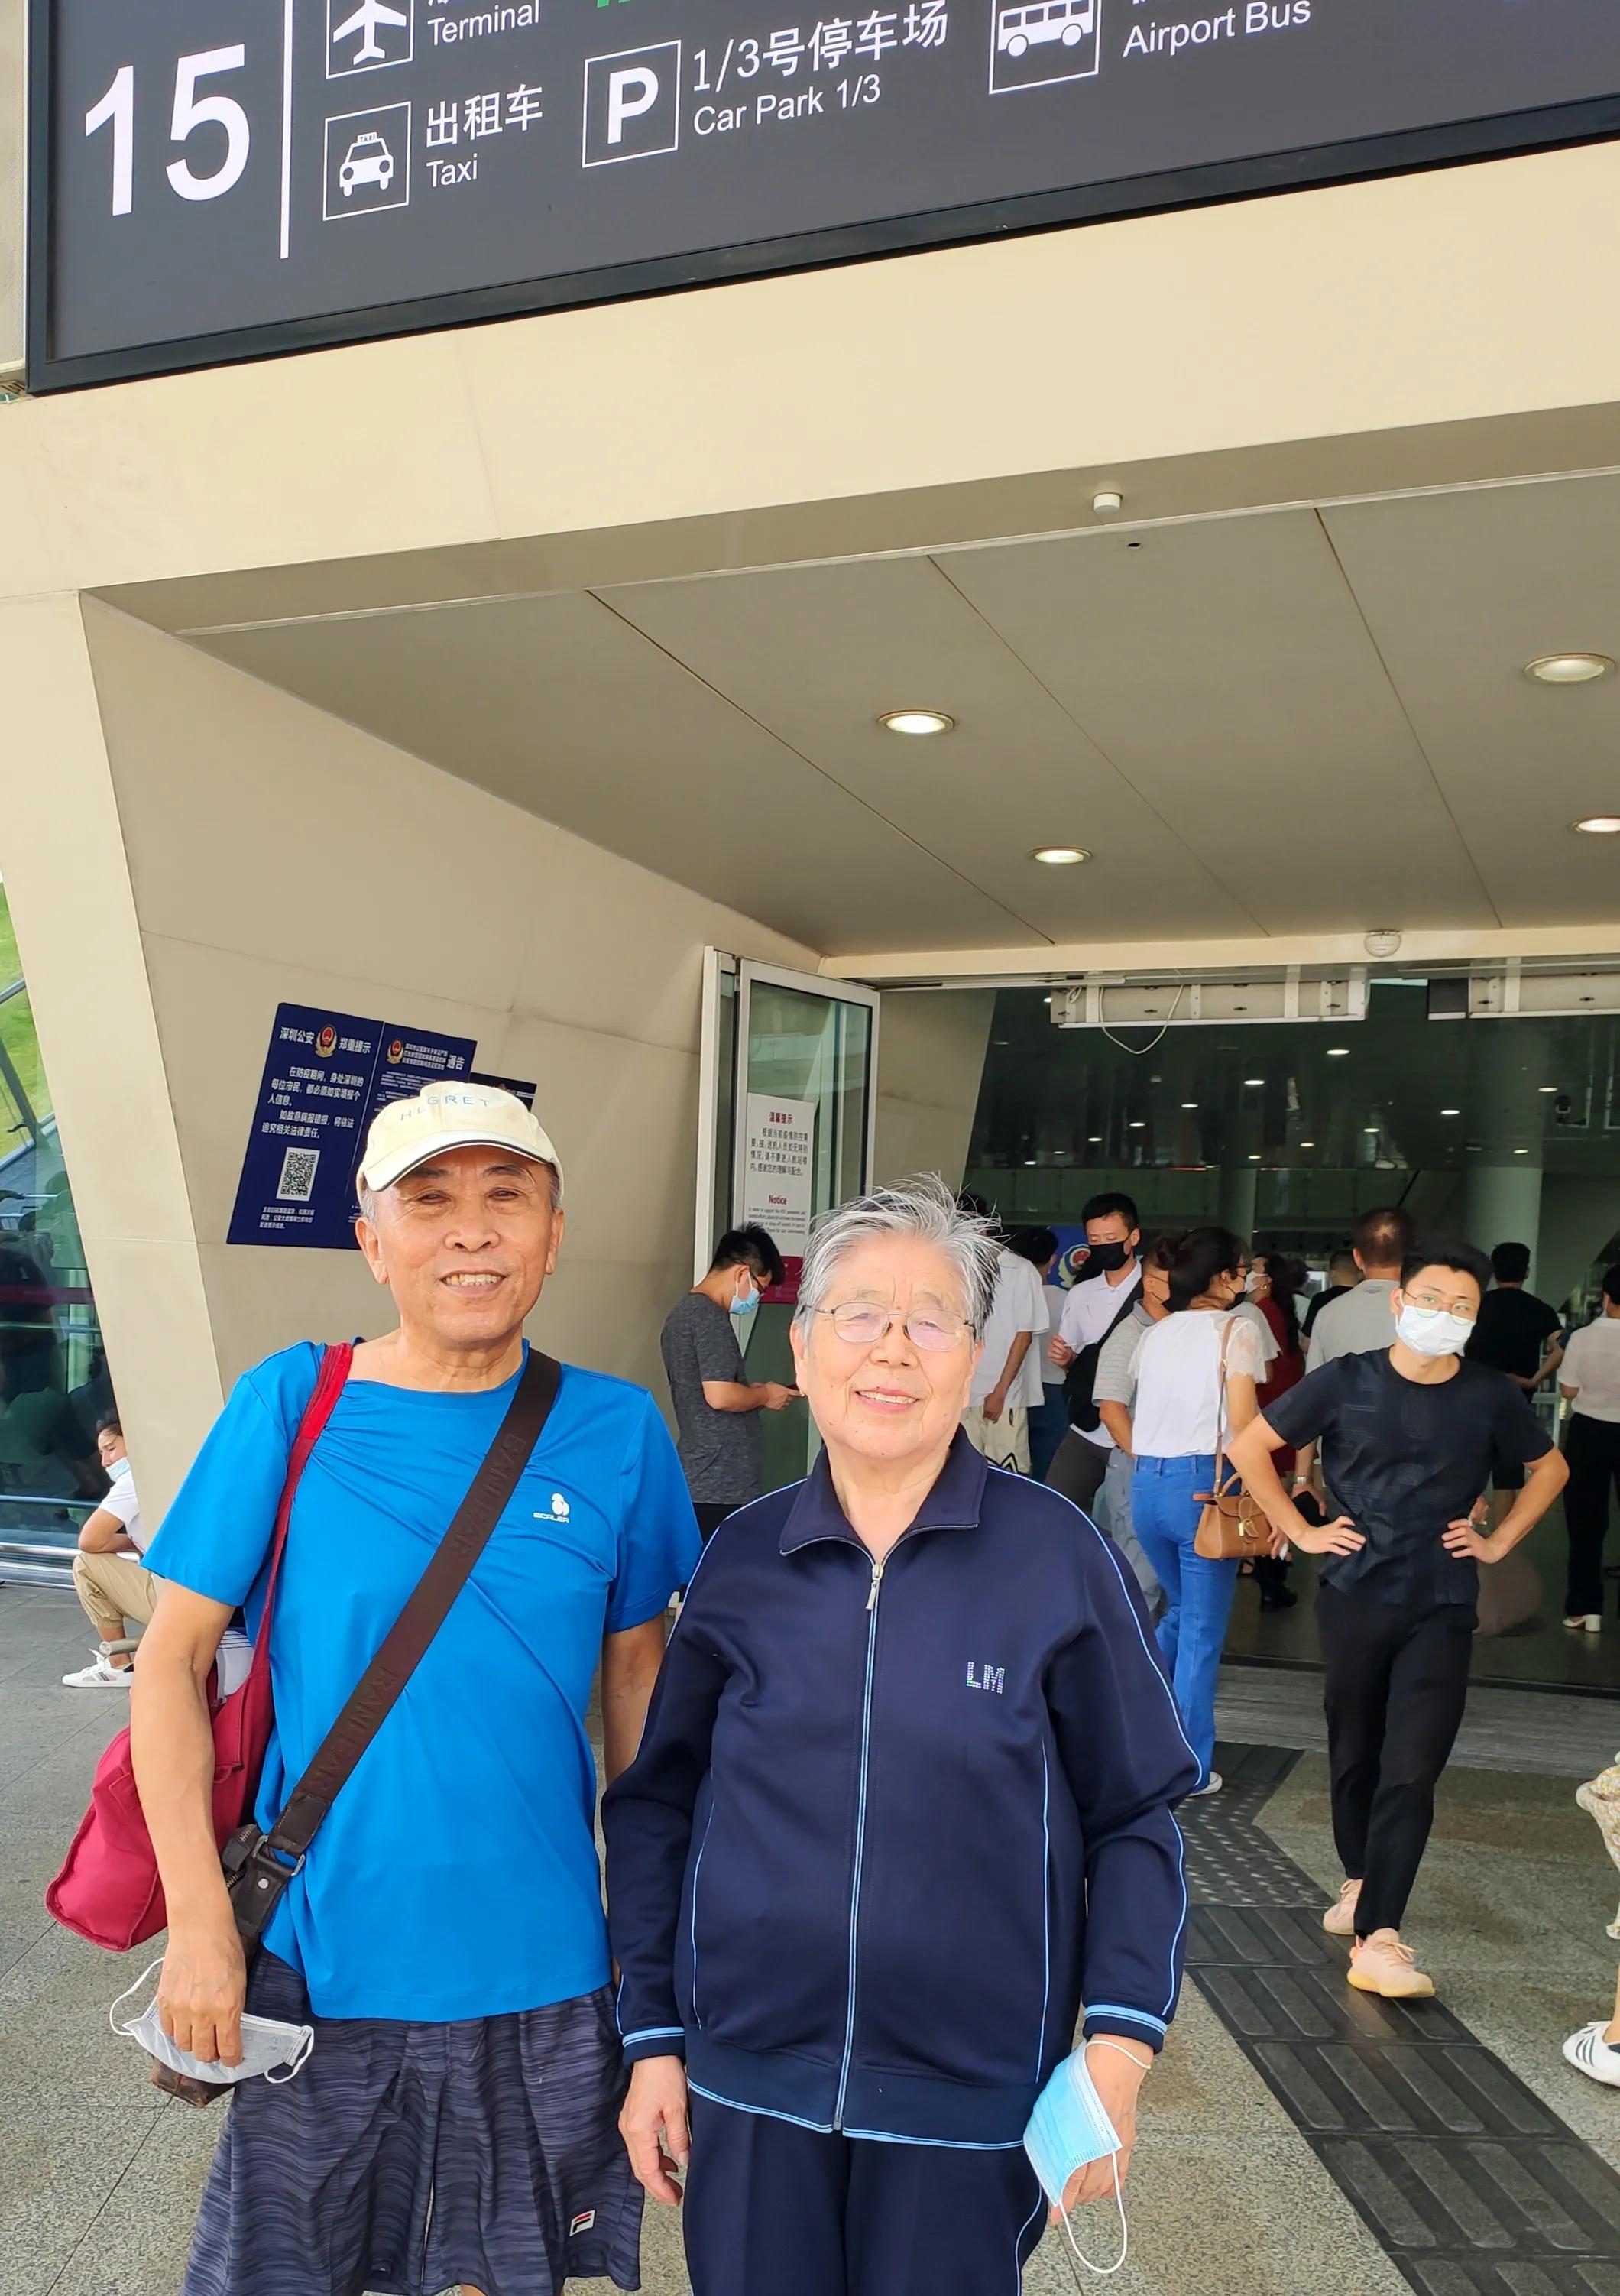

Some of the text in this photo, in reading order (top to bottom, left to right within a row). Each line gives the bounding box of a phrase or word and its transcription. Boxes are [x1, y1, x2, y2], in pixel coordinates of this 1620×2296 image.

[428, 0, 539, 46] Terminal
[693, 0, 948, 92] 1/3号停车场
[1123, 0, 1311, 57] Airport Bus
[426, 83, 543, 148] 出租车
[694, 73, 881, 135] Car Park 1/3
[85, 43, 250, 217] 15
[426, 153, 478, 188] Taxi
[280, 1026, 372, 1054] 深圳公安 郑重提示
[446, 1054, 465, 1070] 通告
[769, 1195, 787, 1205] Notice
[966, 1661, 1006, 1694] LM
